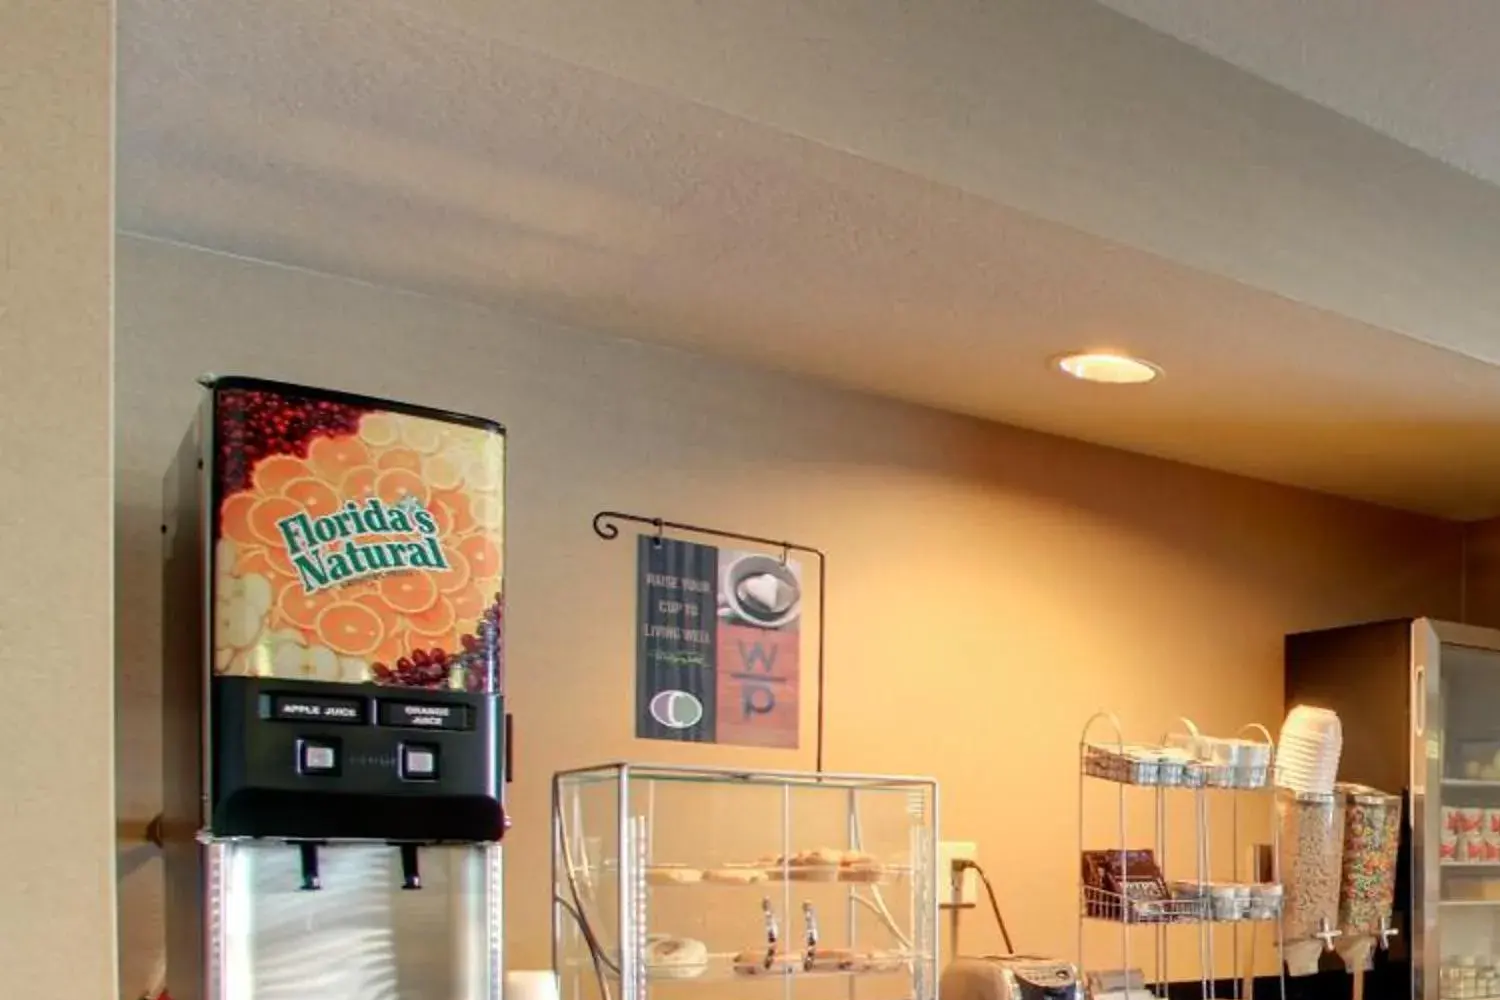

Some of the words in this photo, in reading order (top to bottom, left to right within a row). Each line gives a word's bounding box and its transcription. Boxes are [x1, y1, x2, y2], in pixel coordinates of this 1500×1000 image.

[276, 498, 437, 555] Florida's
[293, 536, 449, 593] Natural
[658, 600, 682, 614] CUP
[283, 703, 320, 716] APPLE
[324, 706, 358, 718] JUICE
[404, 706, 450, 717] ORANGE
[412, 716, 444, 726] JUICE
